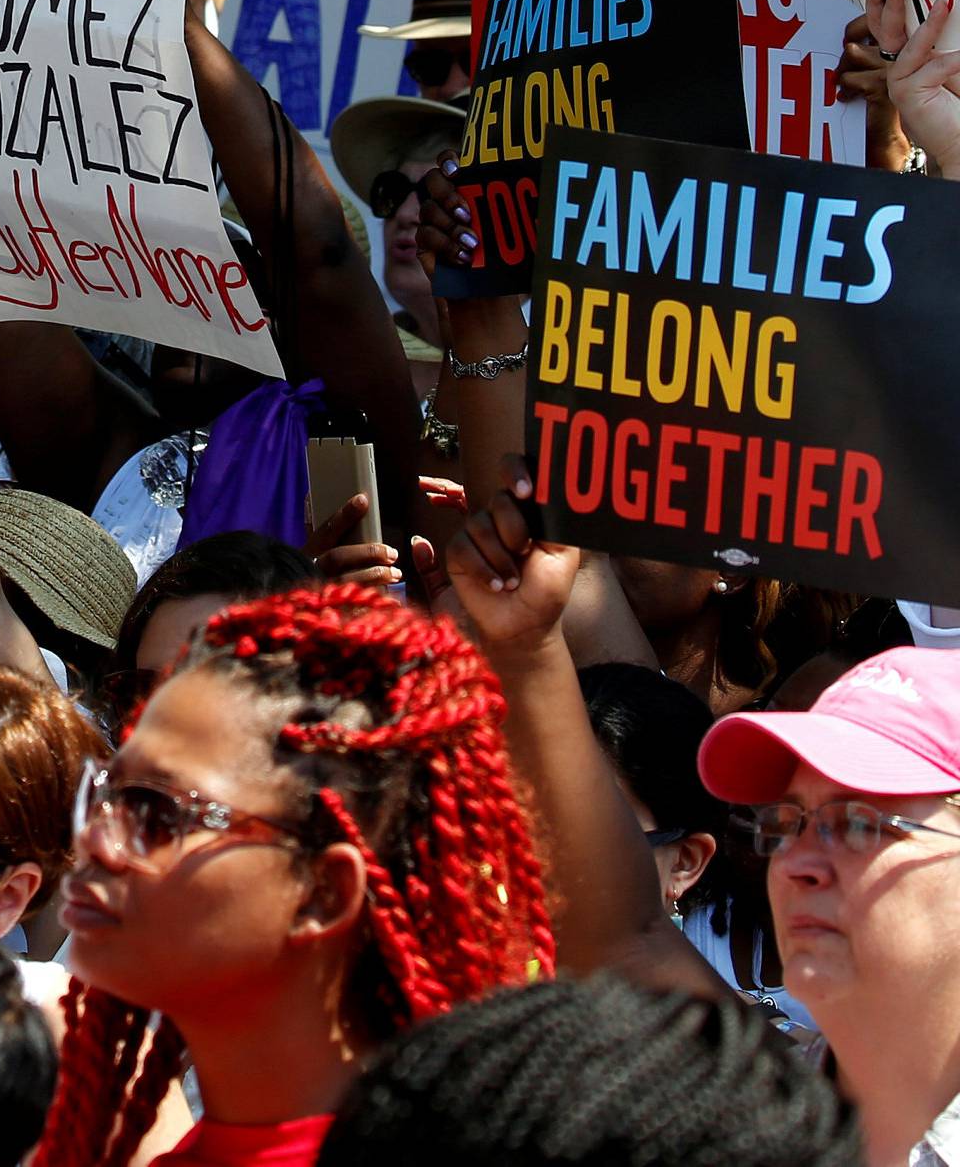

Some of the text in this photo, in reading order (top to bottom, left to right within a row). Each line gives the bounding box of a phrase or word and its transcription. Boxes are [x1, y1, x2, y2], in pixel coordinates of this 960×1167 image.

[460, 62, 615, 169] BELONG
[552, 159, 906, 305] FAMILIES
[538, 279, 799, 420] BELONG
[533, 401, 885, 561] TOGETHER
